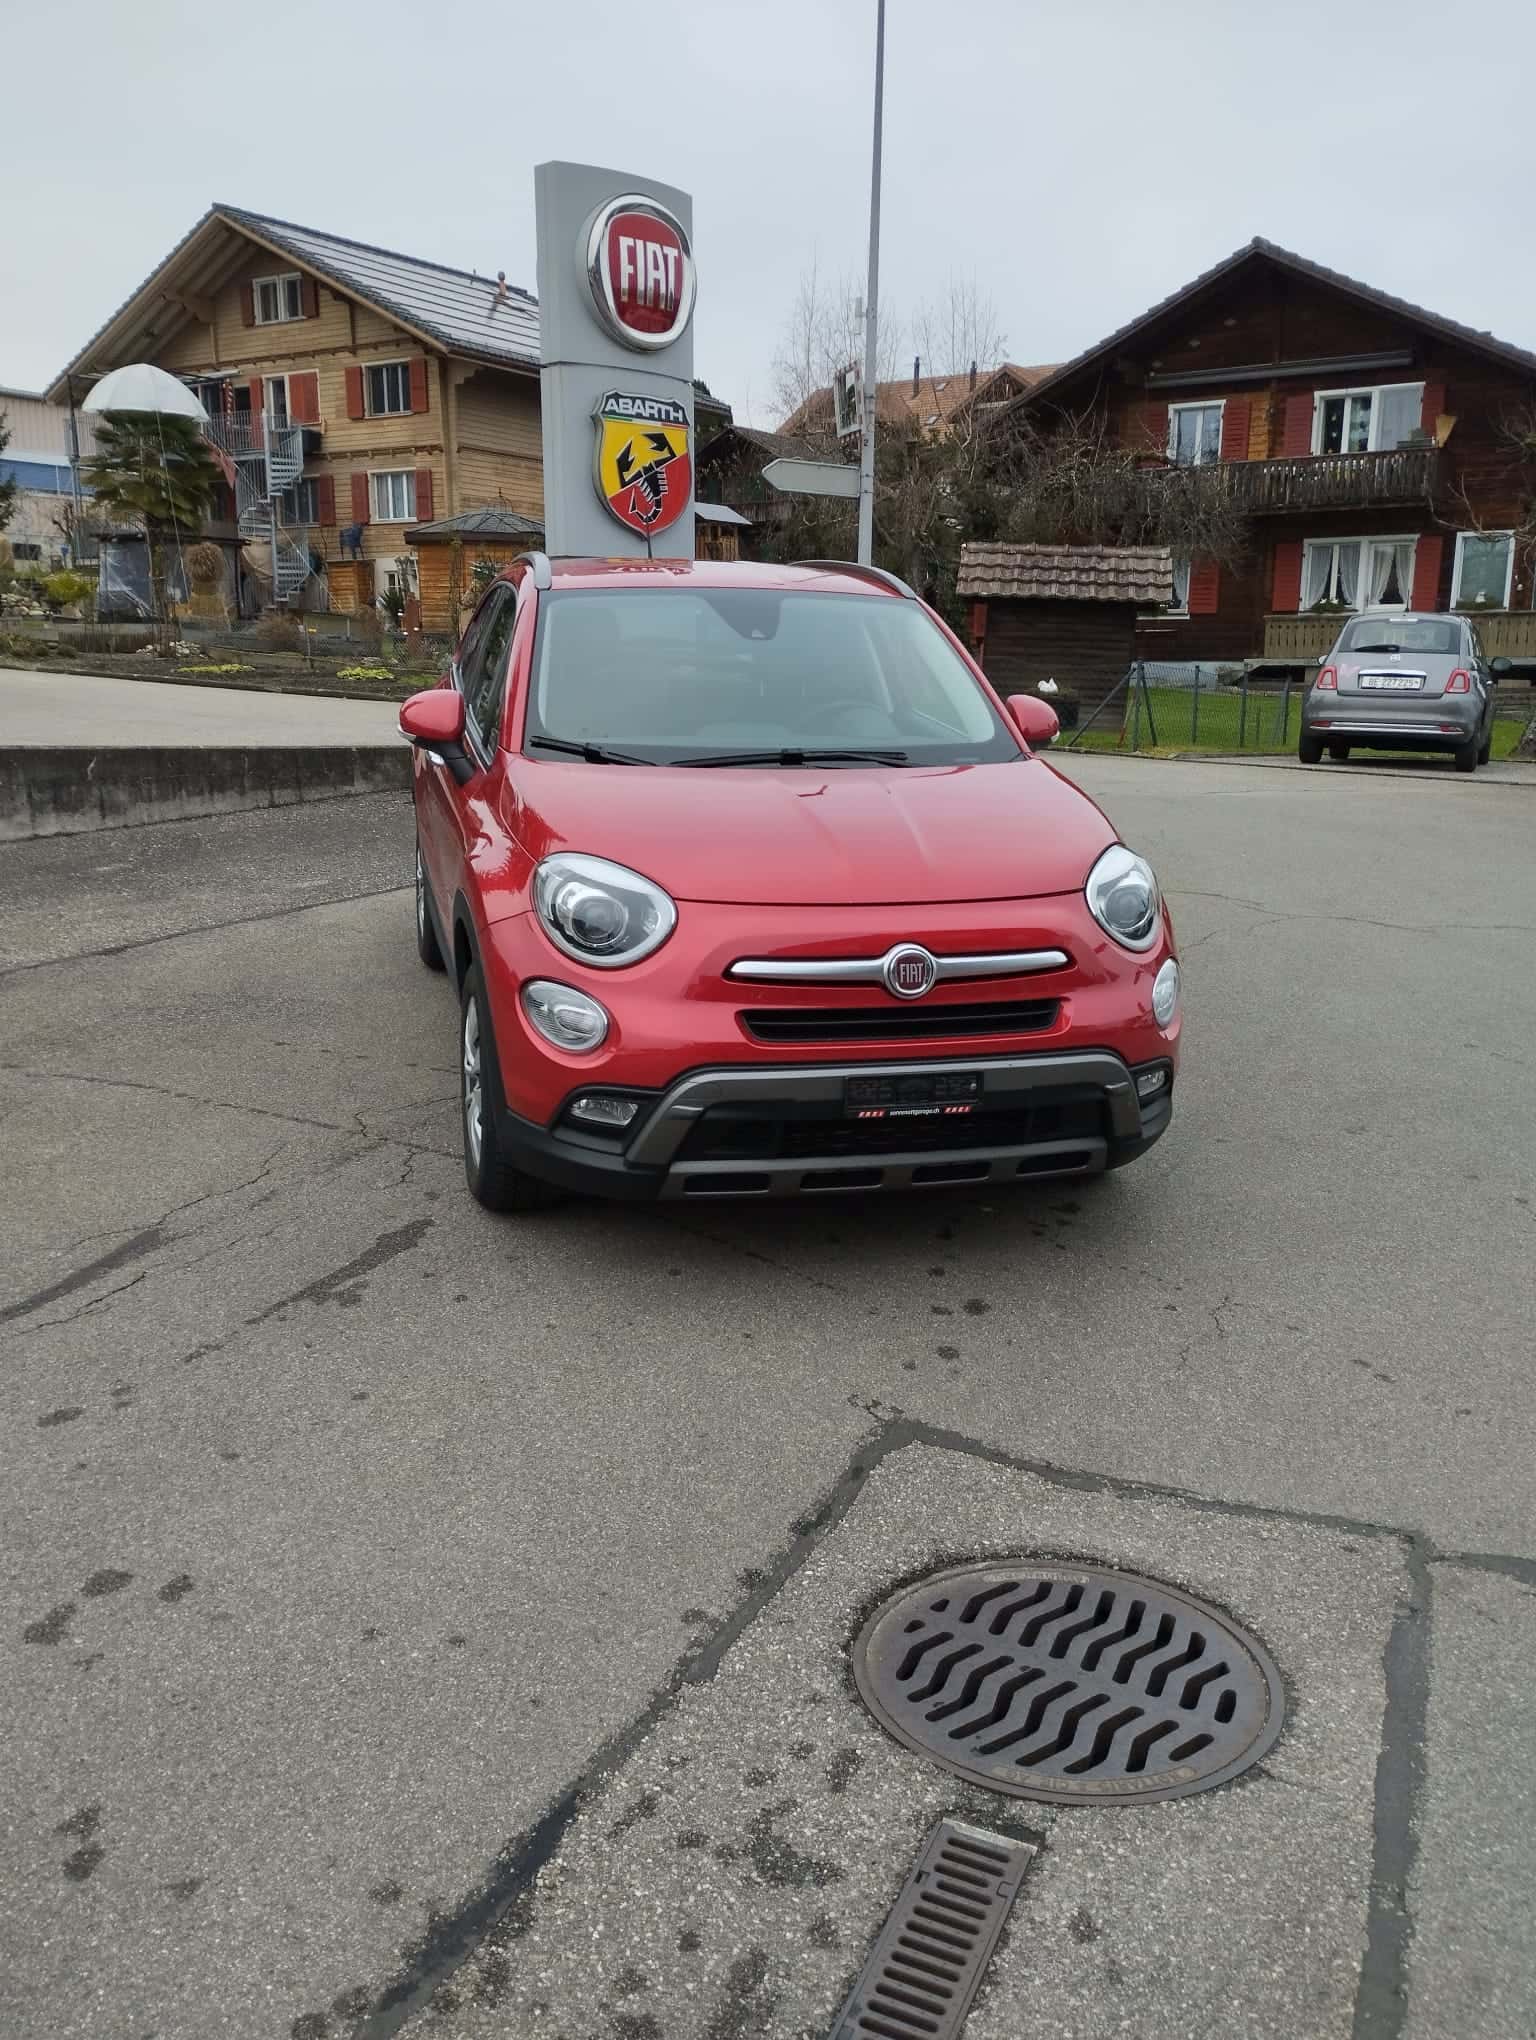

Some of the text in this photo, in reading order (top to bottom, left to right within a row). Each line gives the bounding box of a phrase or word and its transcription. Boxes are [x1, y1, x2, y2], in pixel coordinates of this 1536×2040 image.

[618, 235, 679, 312] FIAT
[605, 397, 684, 422] ABARTH
[899, 962, 924, 984] FIAT
